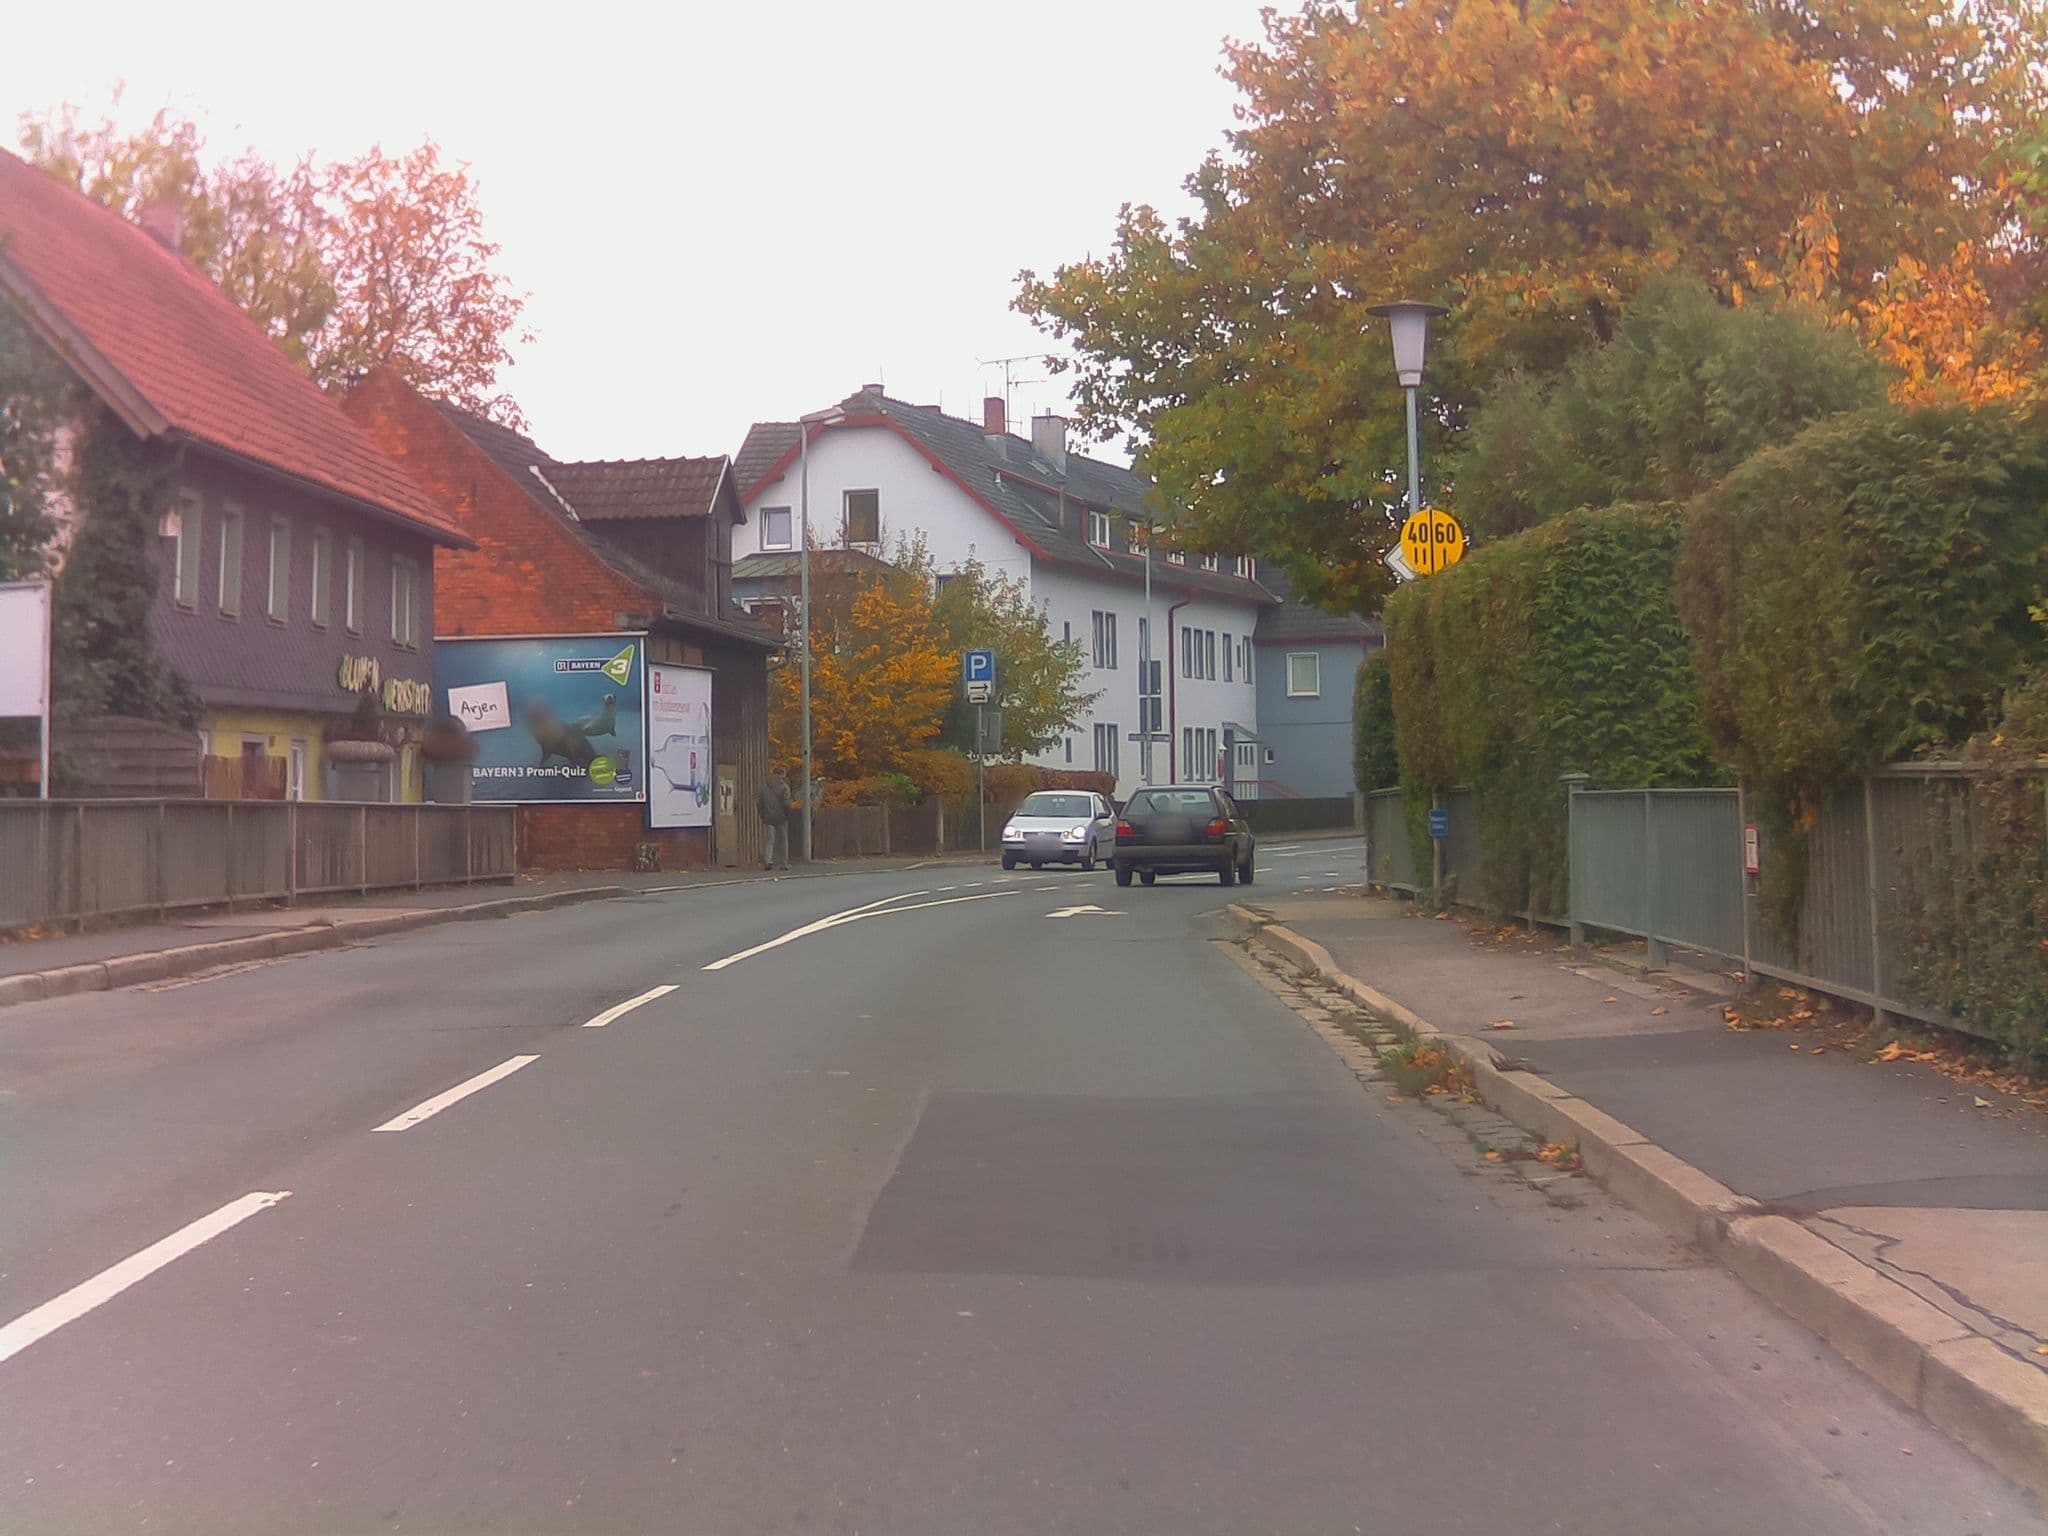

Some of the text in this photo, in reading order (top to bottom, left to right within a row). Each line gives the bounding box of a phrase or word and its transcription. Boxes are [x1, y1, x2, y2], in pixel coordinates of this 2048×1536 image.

[1408, 522, 1456, 544] 40 60
[611, 659, 628, 674] 3
[970, 655, 988, 680] P
[461, 700, 498, 720] Arjen
[526, 766, 586, 778] Promi-Quiz
